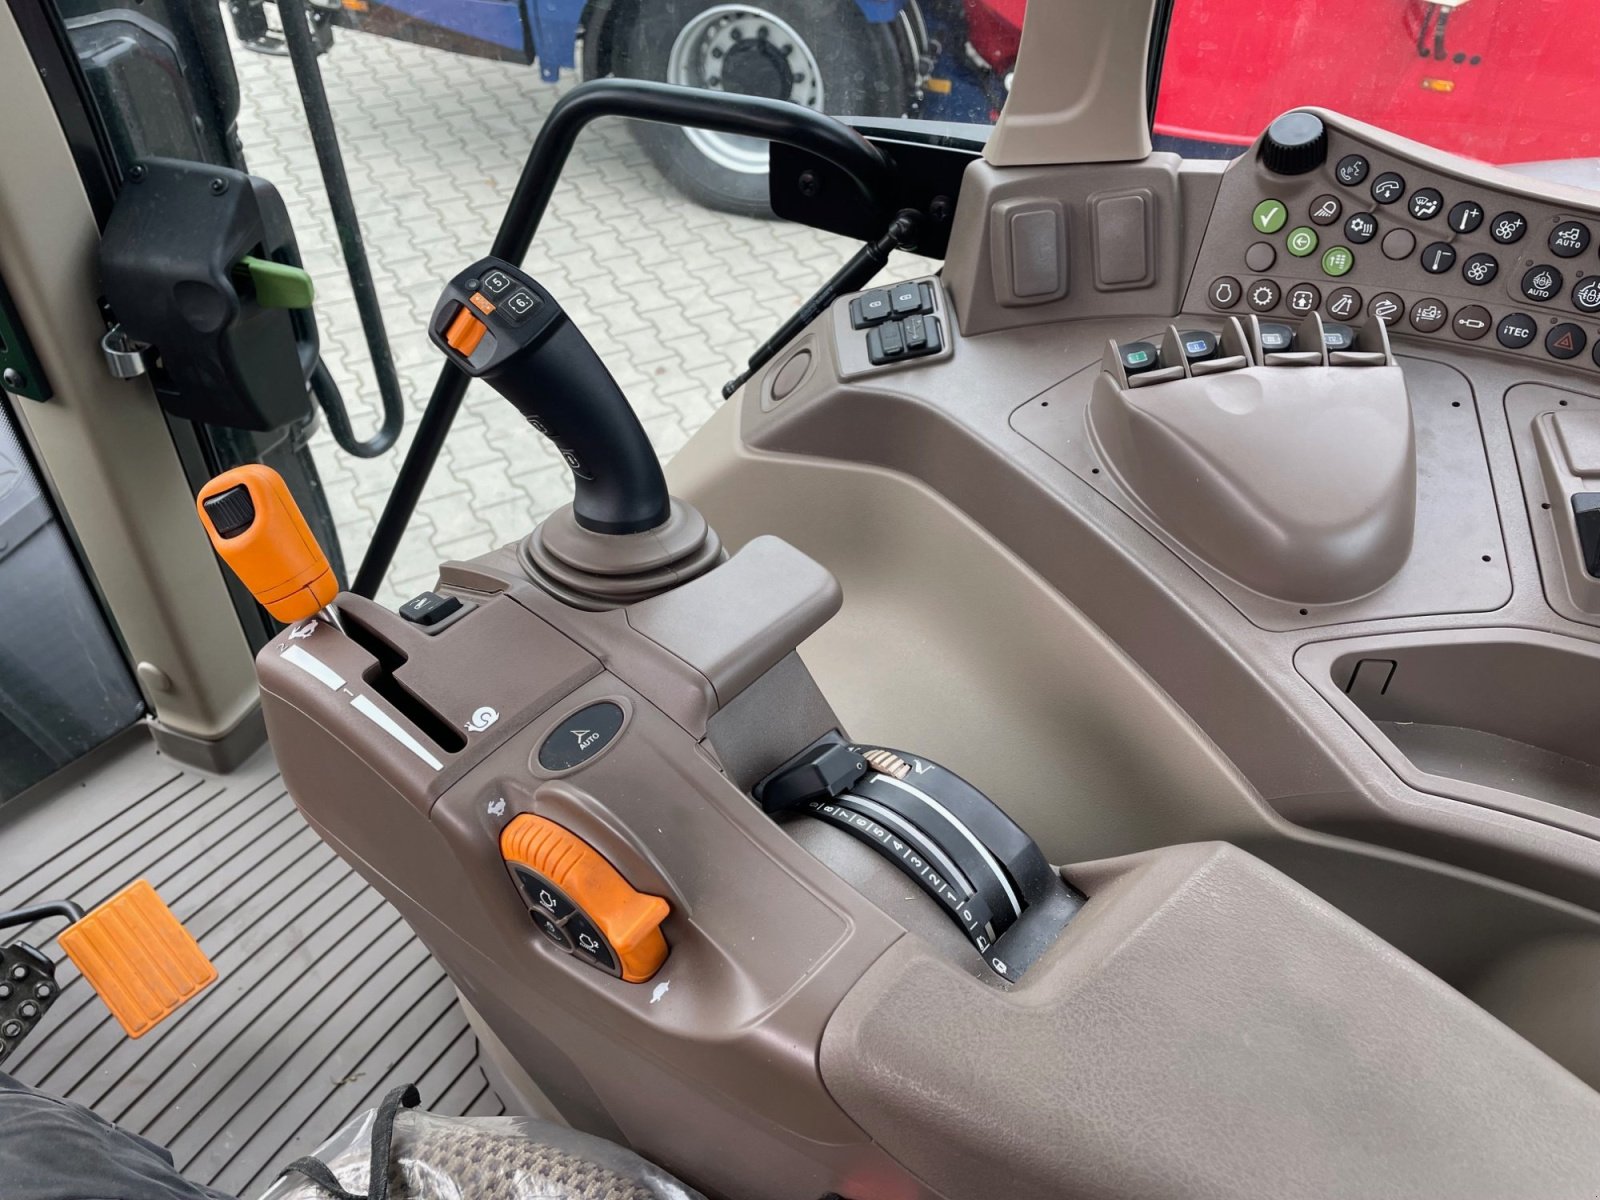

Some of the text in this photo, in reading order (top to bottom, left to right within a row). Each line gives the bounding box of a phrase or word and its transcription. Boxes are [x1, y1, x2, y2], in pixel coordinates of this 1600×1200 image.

[1555, 238, 1581, 249] AUTO
[492, 277, 502, 287] 5
[1527, 288, 1550, 298] AUTO
[1503, 325, 1530, 339] iTEC
[276, 642, 289, 652] 2
[580, 732, 600, 750] AUTO
[838, 810, 849, 818] 7
[856, 818, 867, 826] 6
[872, 827, 884, 837] 5
[893, 840, 903, 851] 4
[910, 856, 922, 867] 3
[928, 873, 940, 886] 2
[946, 891, 957, 902] 1
[963, 909, 972, 922] 0
